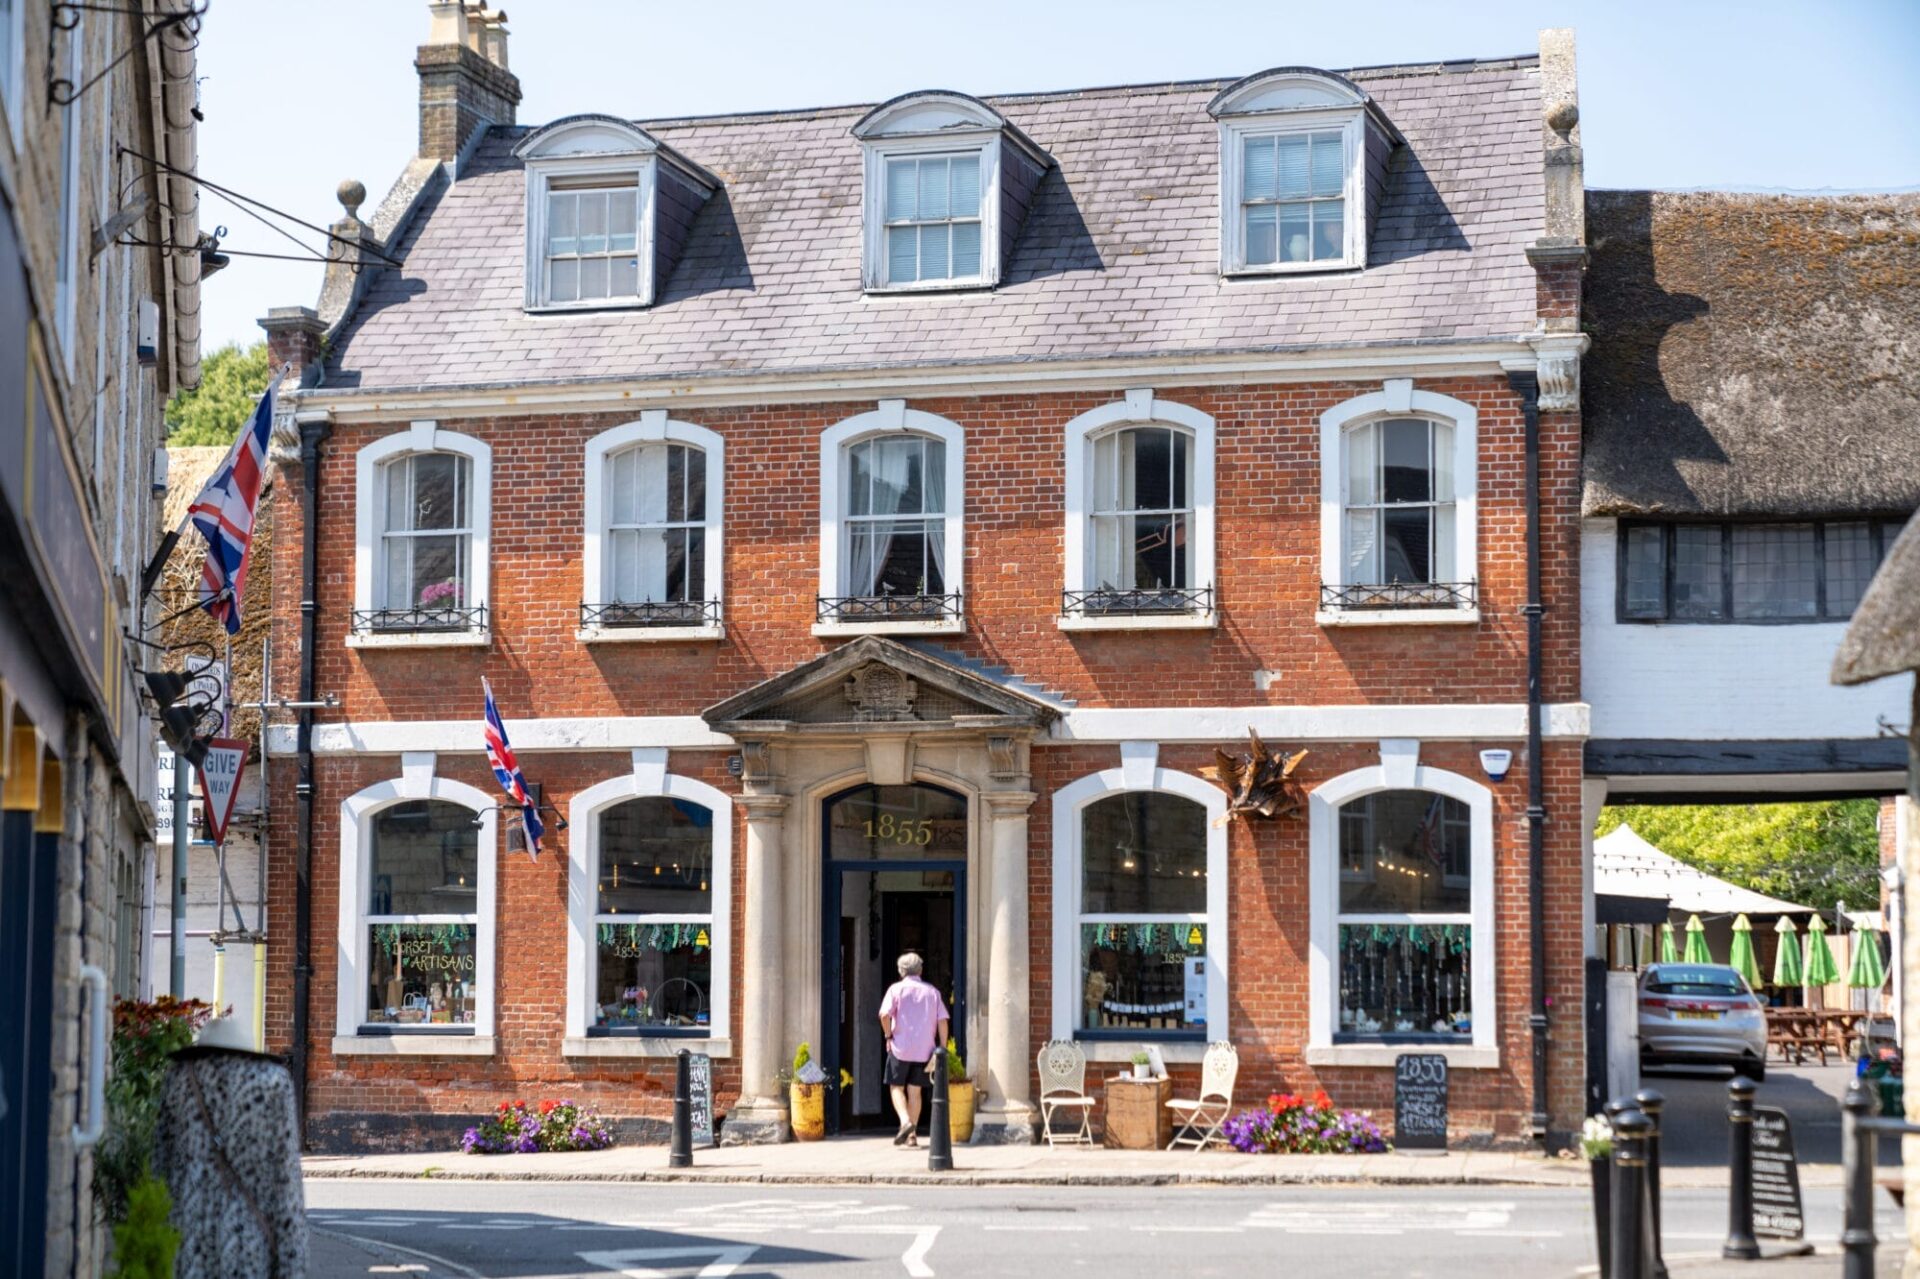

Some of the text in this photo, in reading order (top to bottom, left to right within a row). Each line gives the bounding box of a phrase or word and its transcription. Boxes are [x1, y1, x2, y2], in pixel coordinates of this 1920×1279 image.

[205, 752, 236, 775] GIVE
[210, 780, 230, 794] WAY
[862, 814, 933, 846] 1855
[393, 941, 432, 956] DORSET
[614, 945, 642, 959] 1855
[411, 954, 474, 972] ARTISANS
[1398, 1055, 1446, 1083] 1855
